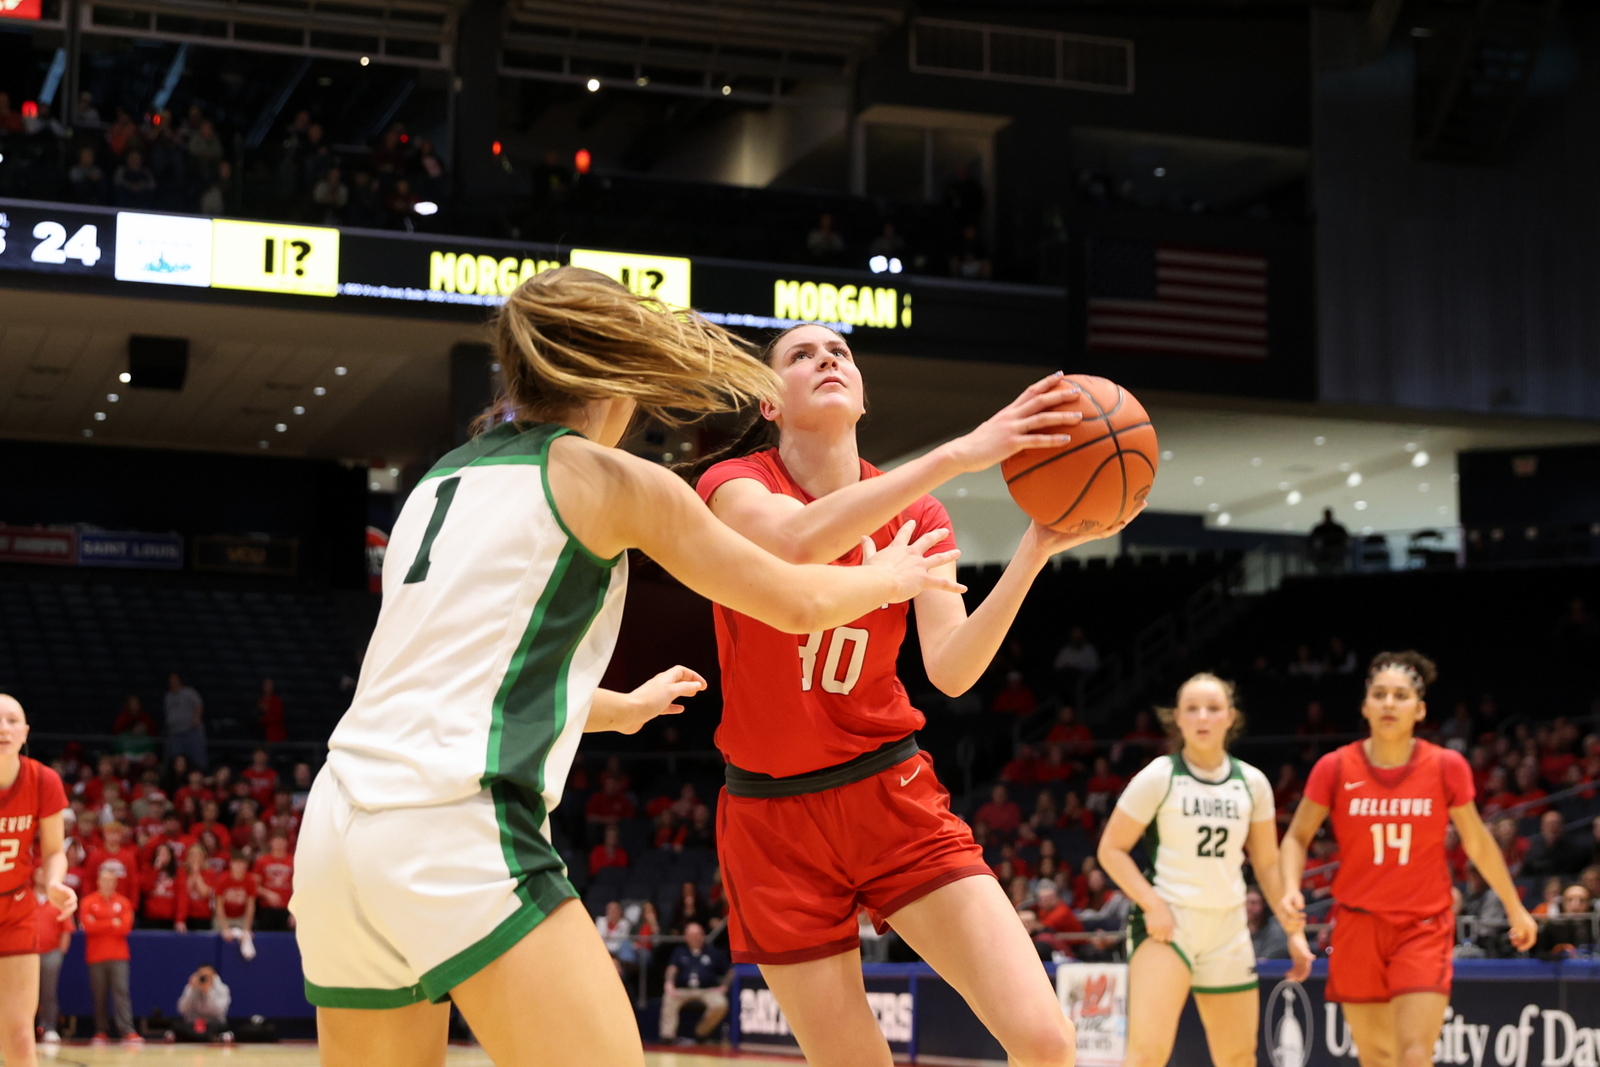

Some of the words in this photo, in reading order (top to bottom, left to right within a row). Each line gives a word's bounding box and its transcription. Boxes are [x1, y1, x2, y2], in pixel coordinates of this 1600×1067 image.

[30, 221, 101, 267] 24
[773, 279, 898, 330] MORGAN
[402, 475, 462, 585] 1
[1182, 796, 1242, 820] LAUREL
[1348, 797, 1433, 817] BELLEVUE
[1197, 825, 1229, 858] 22
[1369, 822, 1413, 866] 14
[1495, 1004, 1540, 1067] of
